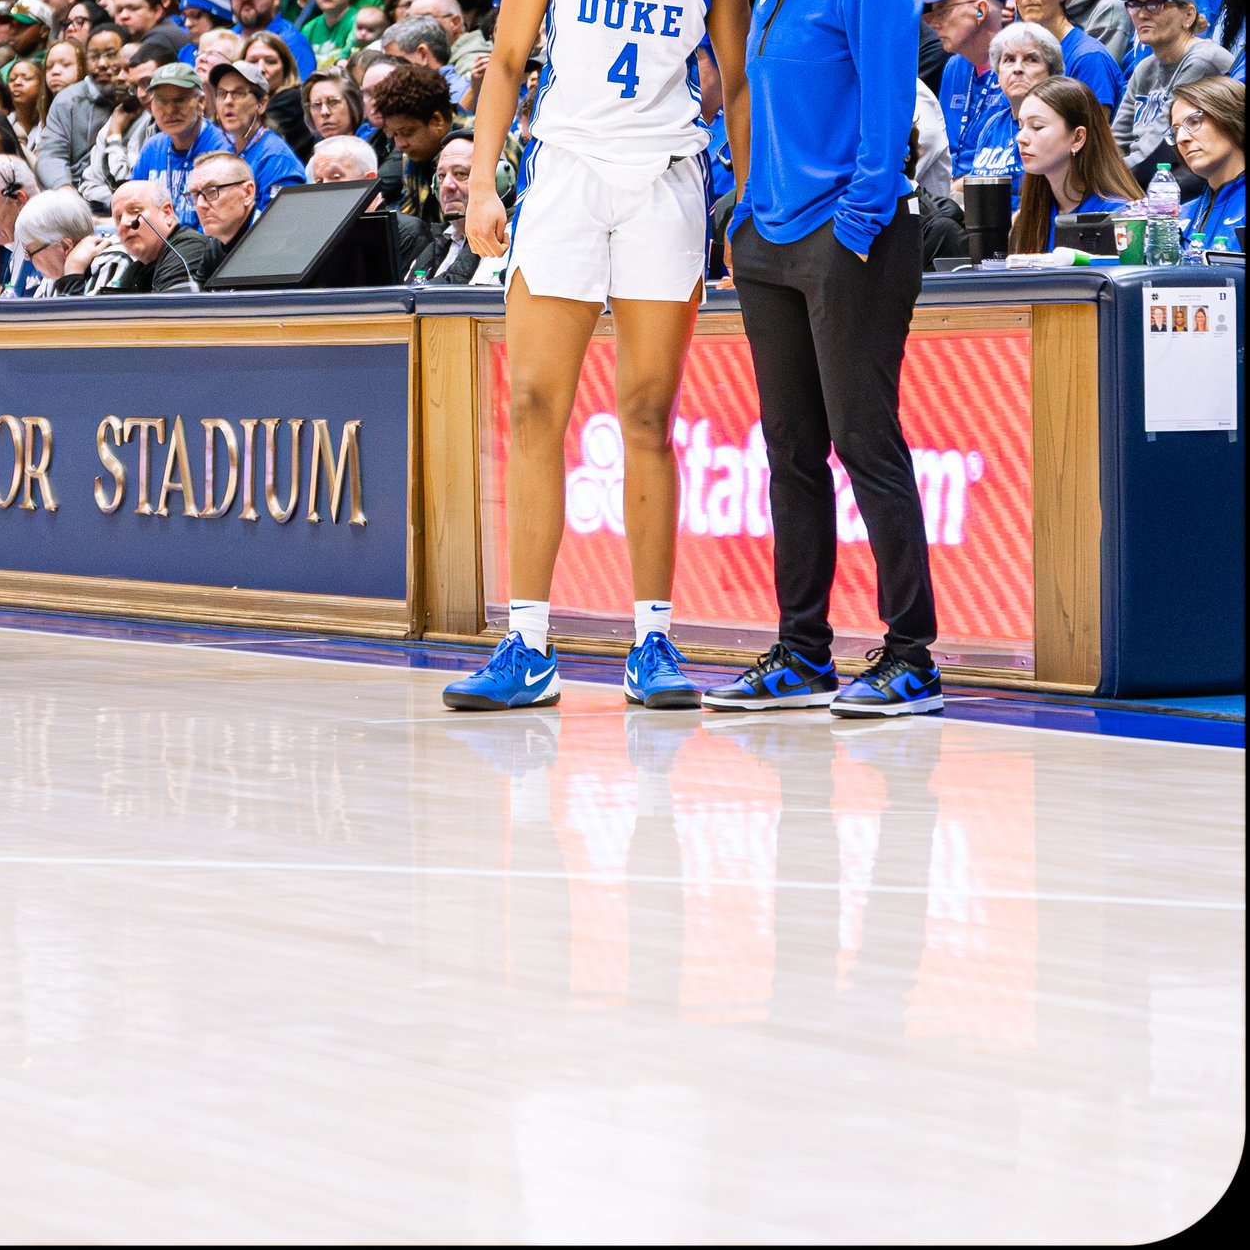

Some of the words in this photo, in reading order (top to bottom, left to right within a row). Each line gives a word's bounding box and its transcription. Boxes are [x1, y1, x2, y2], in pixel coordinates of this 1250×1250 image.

[607, 42, 639, 98] 4
[94, 414, 368, 527] STADIUM
[672, 417, 774, 538] tat
